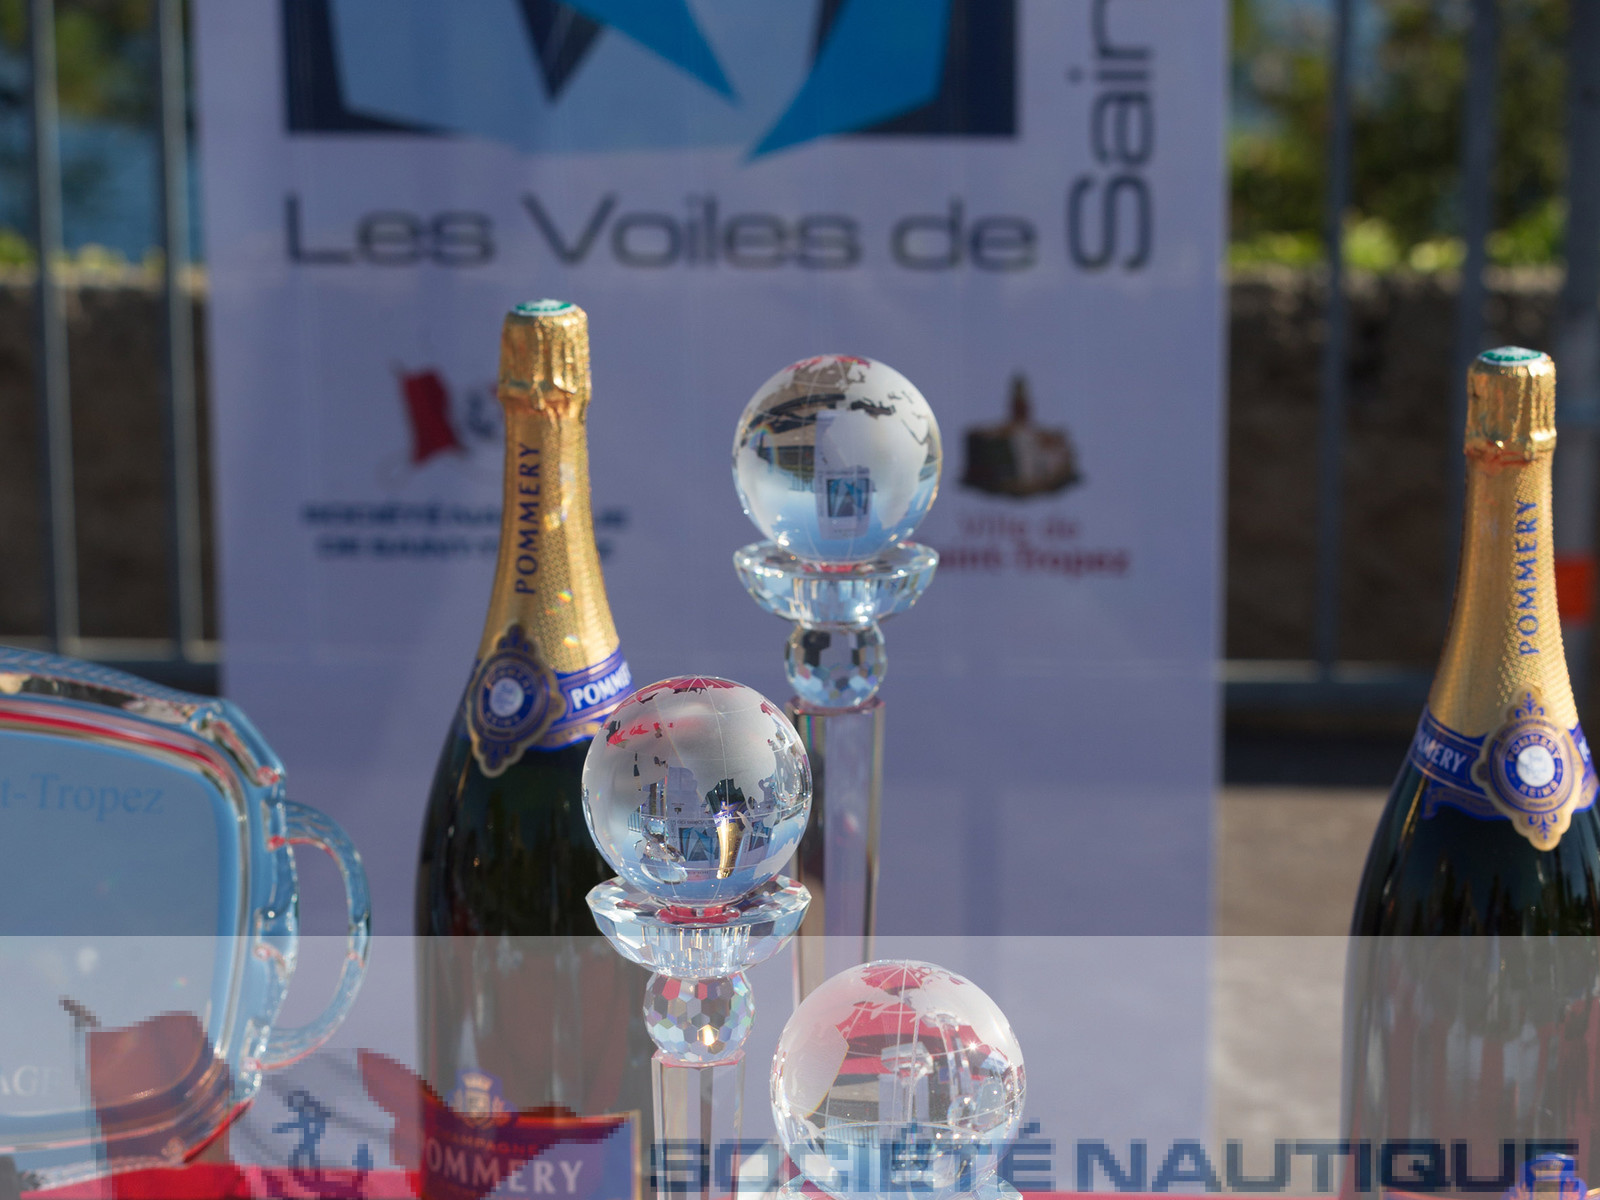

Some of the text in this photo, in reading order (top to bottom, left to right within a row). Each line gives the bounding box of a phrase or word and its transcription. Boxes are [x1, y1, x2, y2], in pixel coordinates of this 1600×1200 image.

[284, 194, 1038, 272] Les Voiles de
[514, 443, 540, 595] POMMERY
[1515, 500, 1540, 656] POMMERY
[424, 1136, 585, 1195] OMMERY
